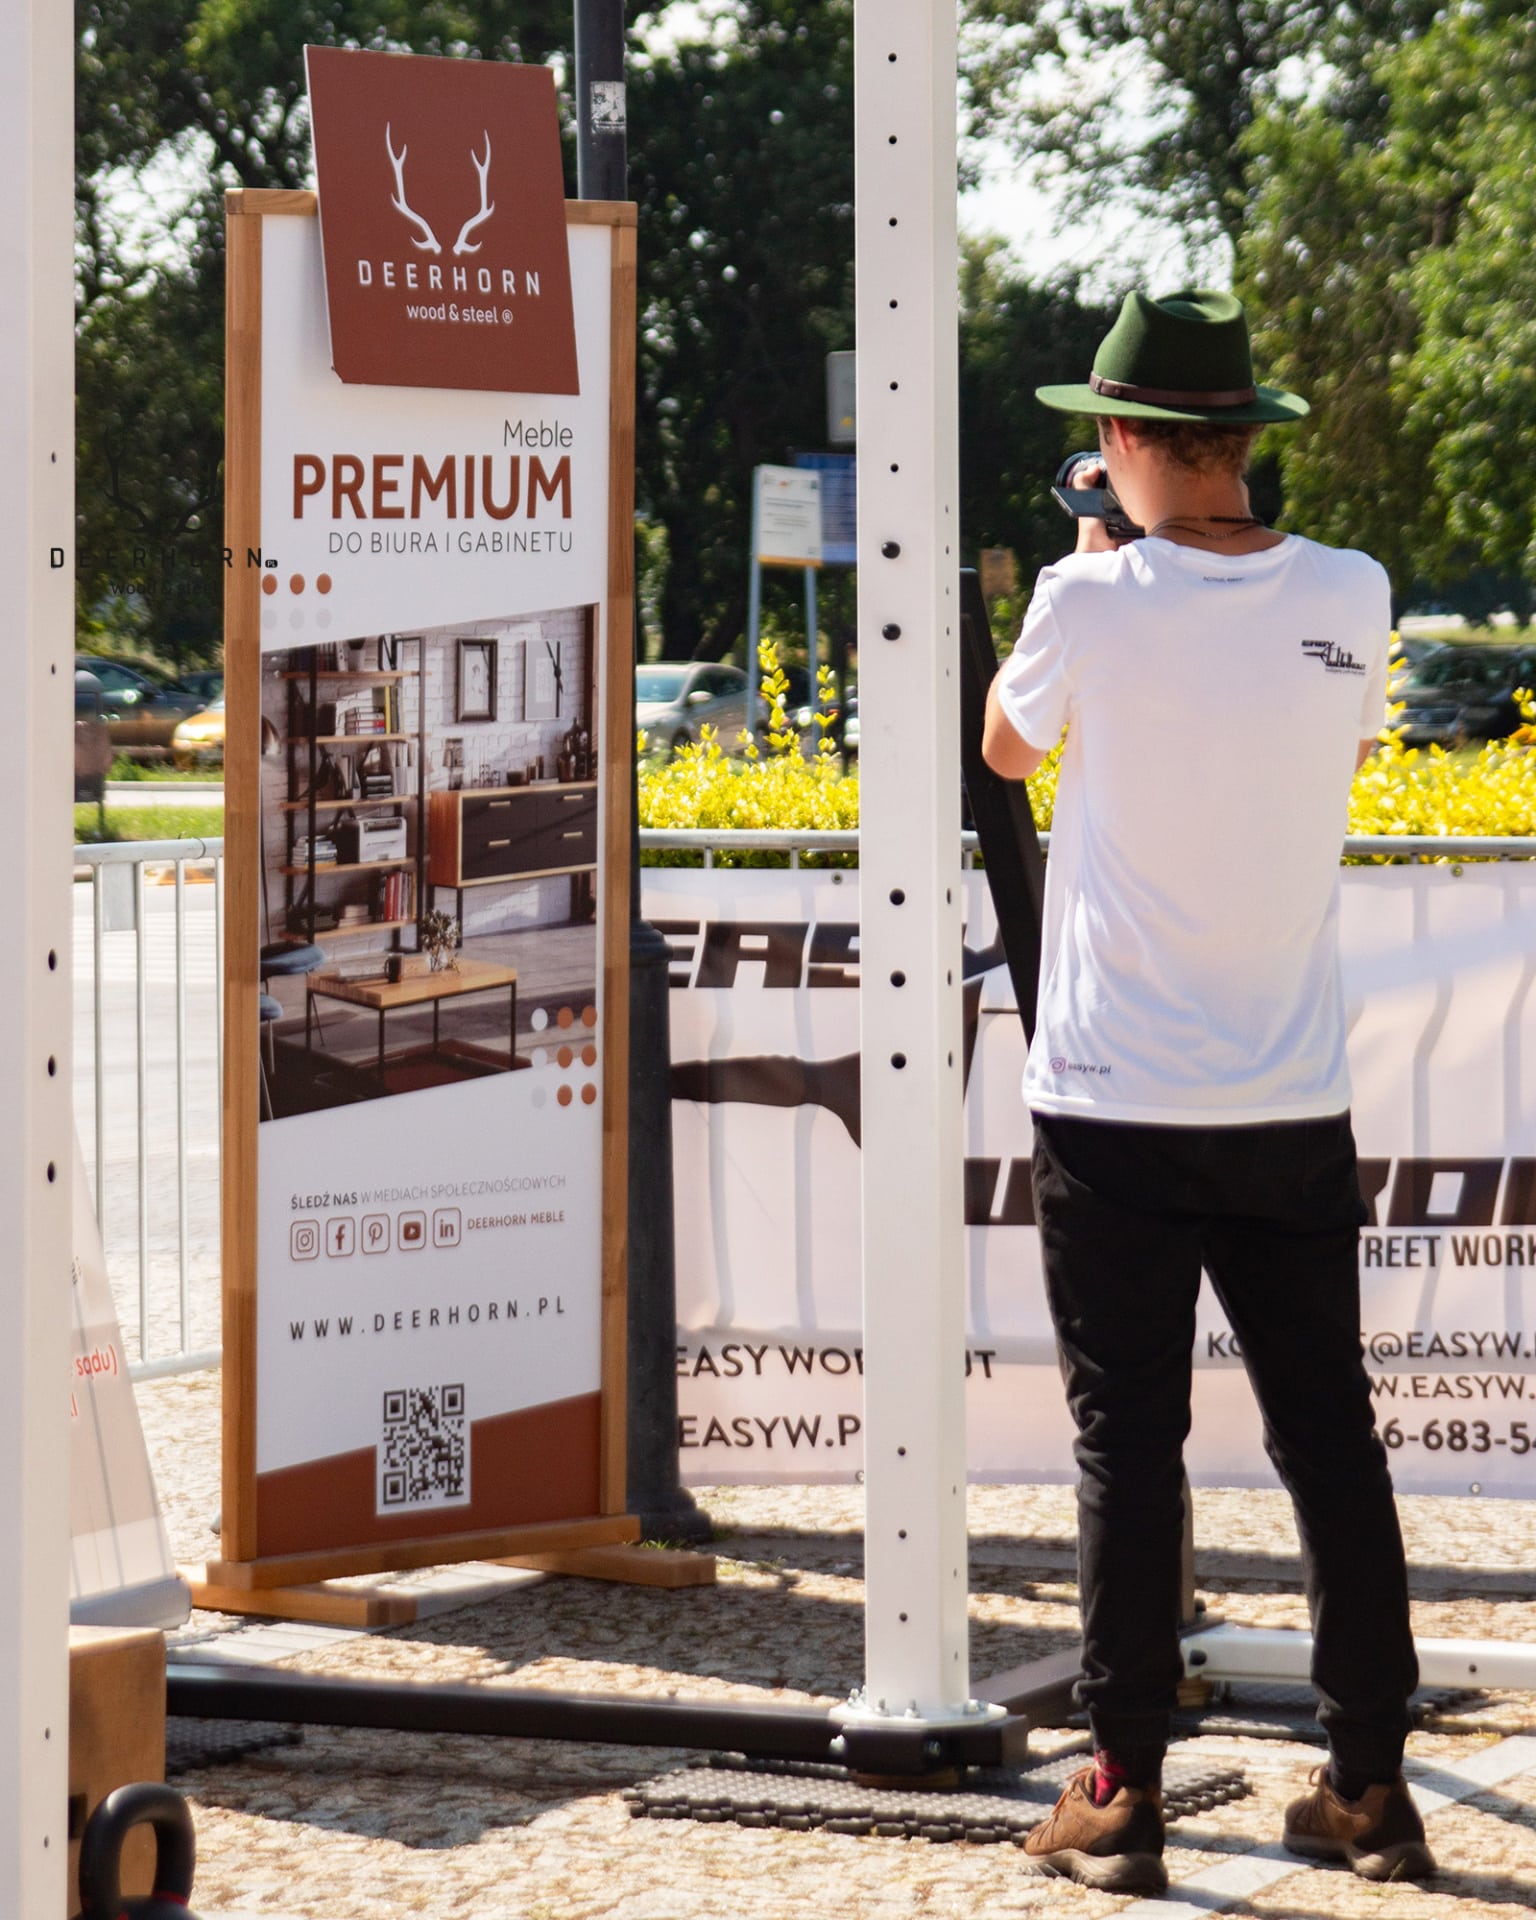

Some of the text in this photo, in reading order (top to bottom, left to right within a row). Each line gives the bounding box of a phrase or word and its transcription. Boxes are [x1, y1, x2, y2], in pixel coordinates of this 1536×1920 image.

[358, 260, 541, 296] DEERHORN
[406, 303, 446, 321] wood
[449, 303, 459, 321] &
[463, 306, 498, 323] steel
[503, 419, 573, 448] Meble
[293, 454, 572, 520] PREMIUM
[329, 532, 362, 553] DO
[371, 532, 438, 553] BIURA
[458, 531, 573, 553] GABINETU
[291, 1190, 329, 1210] ŚLEDŹ
[333, 1191, 358, 1206] NAS
[361, 1192, 371, 1203] W
[374, 1186, 428, 1202] MEDIACH
[467, 1213, 526, 1230] DEERHORN
[531, 1210, 565, 1224] MEBLE
[1359, 1234, 1440, 1267] REET
[290, 1296, 565, 1340] WWW.DEERHORN.PL
